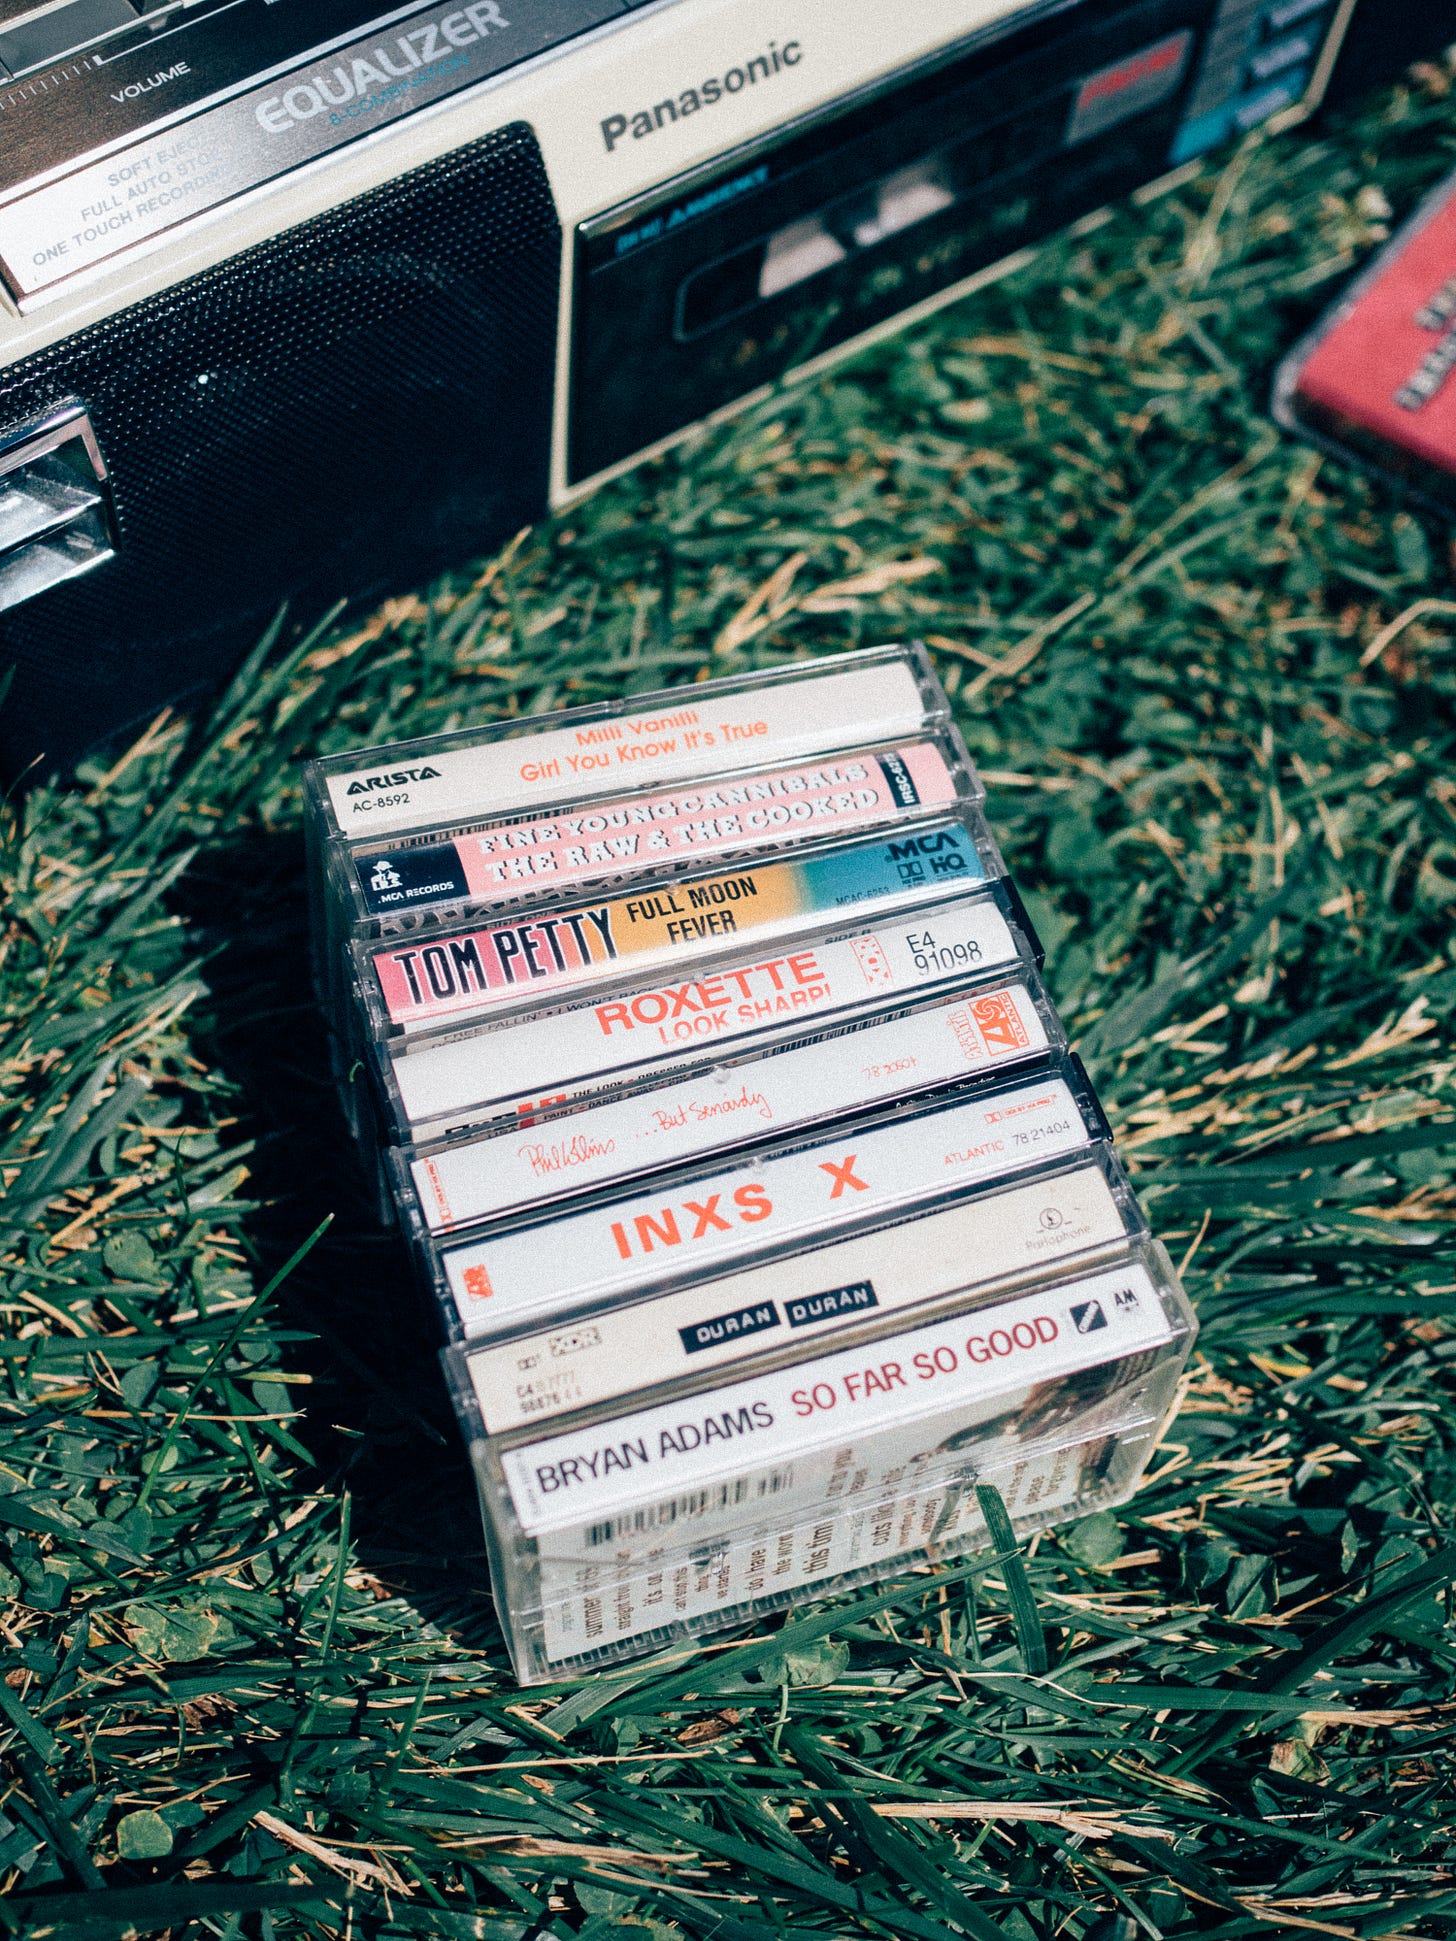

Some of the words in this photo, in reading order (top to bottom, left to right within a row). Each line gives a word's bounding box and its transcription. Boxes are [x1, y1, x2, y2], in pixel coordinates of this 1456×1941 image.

[110, 61, 191, 103] VOLUME
[255, 0, 511, 133] EQUALIZER
[601, 36, 804, 152] Panasonic
[108, 156, 152, 187] SOFT
[81, 195, 122, 221] FULL
[128, 171, 172, 201] AUTO
[33, 240, 69, 266] ONE
[72, 210, 133, 247] TOUCH
[520, 758, 561, 782] Girl
[566, 752, 611, 774] You
[616, 738, 676, 764] Know
[683, 729, 716, 750] It's
[721, 721, 769, 743] True
[575, 725, 623, 748] Milli
[627, 710, 700, 736] Vanilli
[346, 766, 442, 796] ARISTA
[352, 793, 410, 813] AC-8592
[477, 824, 562, 854] FINE
[564, 803, 682, 838] YOUNG
[684, 763, 869, 816] CANNIBALS
[485, 852, 558, 882] THE
[562, 834, 640, 866] RAW
[648, 829, 669, 852] &
[673, 811, 743, 841] THE
[747, 788, 879, 830] COOKED
[886, 831, 960, 862] MCA
[406, 882, 455, 898] RECORDS
[626, 894, 685, 923] FULL
[689, 876, 758, 908] MOON
[666, 909, 737, 945] FEVER
[906, 931, 936, 954] E4
[392, 937, 490, 1005] TOM
[491, 907, 619, 985] PETTY
[914, 940, 983, 977] 91098
[594, 952, 826, 1036] ROXETTE
[658, 1010, 731, 1045] LOOK
[738, 983, 832, 1024] SHARP!
[999, 993, 1028, 1047] ATLANTIC
[944, 1139, 1005, 1166] ATLANTIC
[1012, 1133, 1029, 1145] 78
[1030, 1120, 1070, 1141] 21404
[610, 1183, 774, 1260] INXS
[818, 1154, 871, 1200] X
[696, 1307, 772, 1343] DURAN
[791, 1287, 869, 1323] DURAN
[536, 1437, 650, 1493] BRYAN
[658, 1401, 774, 1459] ADAMS
[791, 1384, 836, 1417] SO
[843, 1361, 907, 1402] FAR
[913, 1347, 958, 1380] SO
[966, 1316, 1059, 1364] GOOD
[871, 1522, 893, 1546] cuts
[744, 1548, 767, 1574] have
[802, 1548, 830, 1575] this
